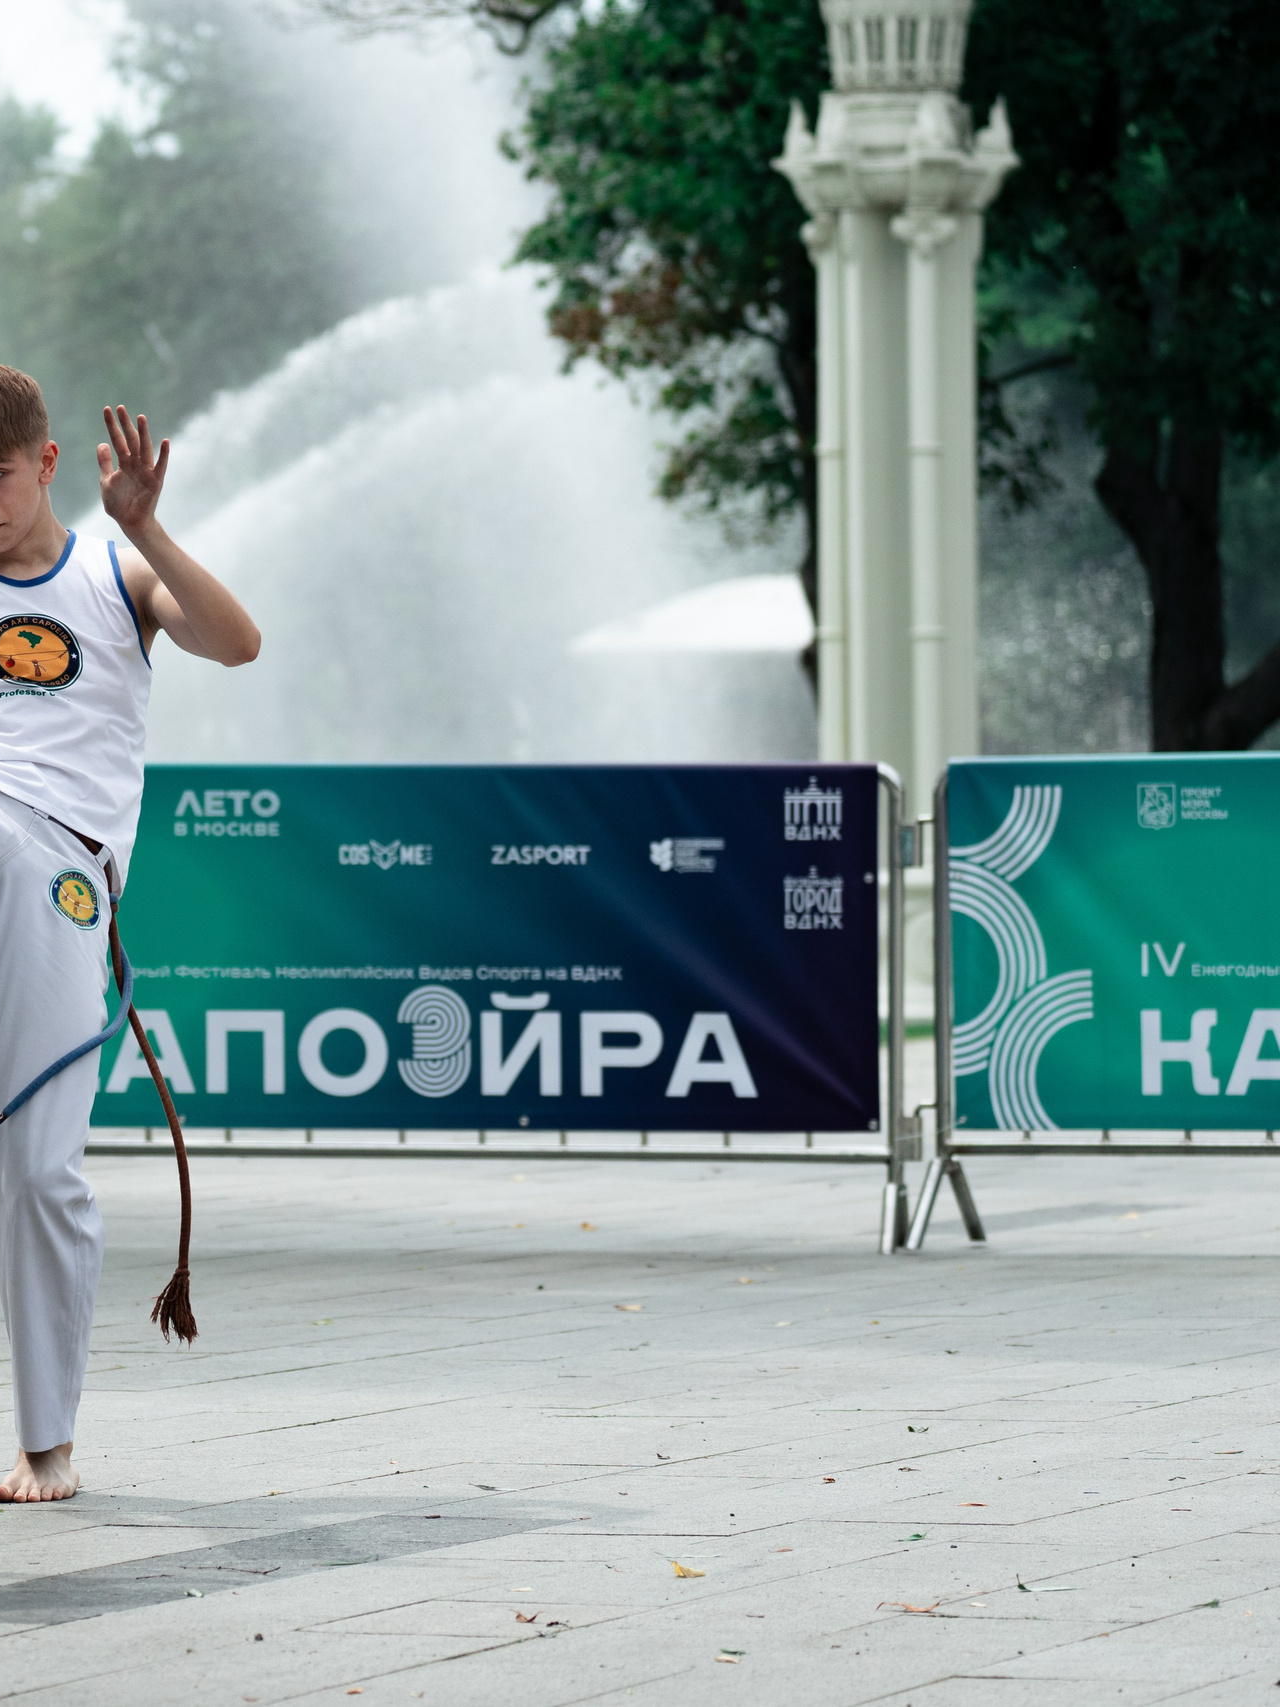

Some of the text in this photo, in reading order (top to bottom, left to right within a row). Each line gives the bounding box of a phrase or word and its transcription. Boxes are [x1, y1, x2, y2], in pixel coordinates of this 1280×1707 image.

[11, 617, 29, 626] AXÉ
[32, 617, 71, 645] CAPOEIRA
[0, 688, 47, 698] Professor
[175, 789, 280, 818] ЛЕТО
[174, 821, 280, 837] В МОСКВЕ
[784, 824, 842, 841] ВДНХ
[491, 845, 591, 866] ZASPORT
[784, 888, 842, 914] ГОРОД
[784, 914, 843, 930] ВДНХ
[1140, 942, 1280, 979] IV Ежегодны
[174, 964, 272, 979] Фестиваль
[275, 965, 414, 980] Неолимпийских
[420, 965, 472, 982] Видов
[476, 964, 542, 981] Спорта
[545, 968, 567, 981] на
[571, 966, 623, 982] ВДНХ
[97, 985, 758, 1098] АПОЭЙРА
